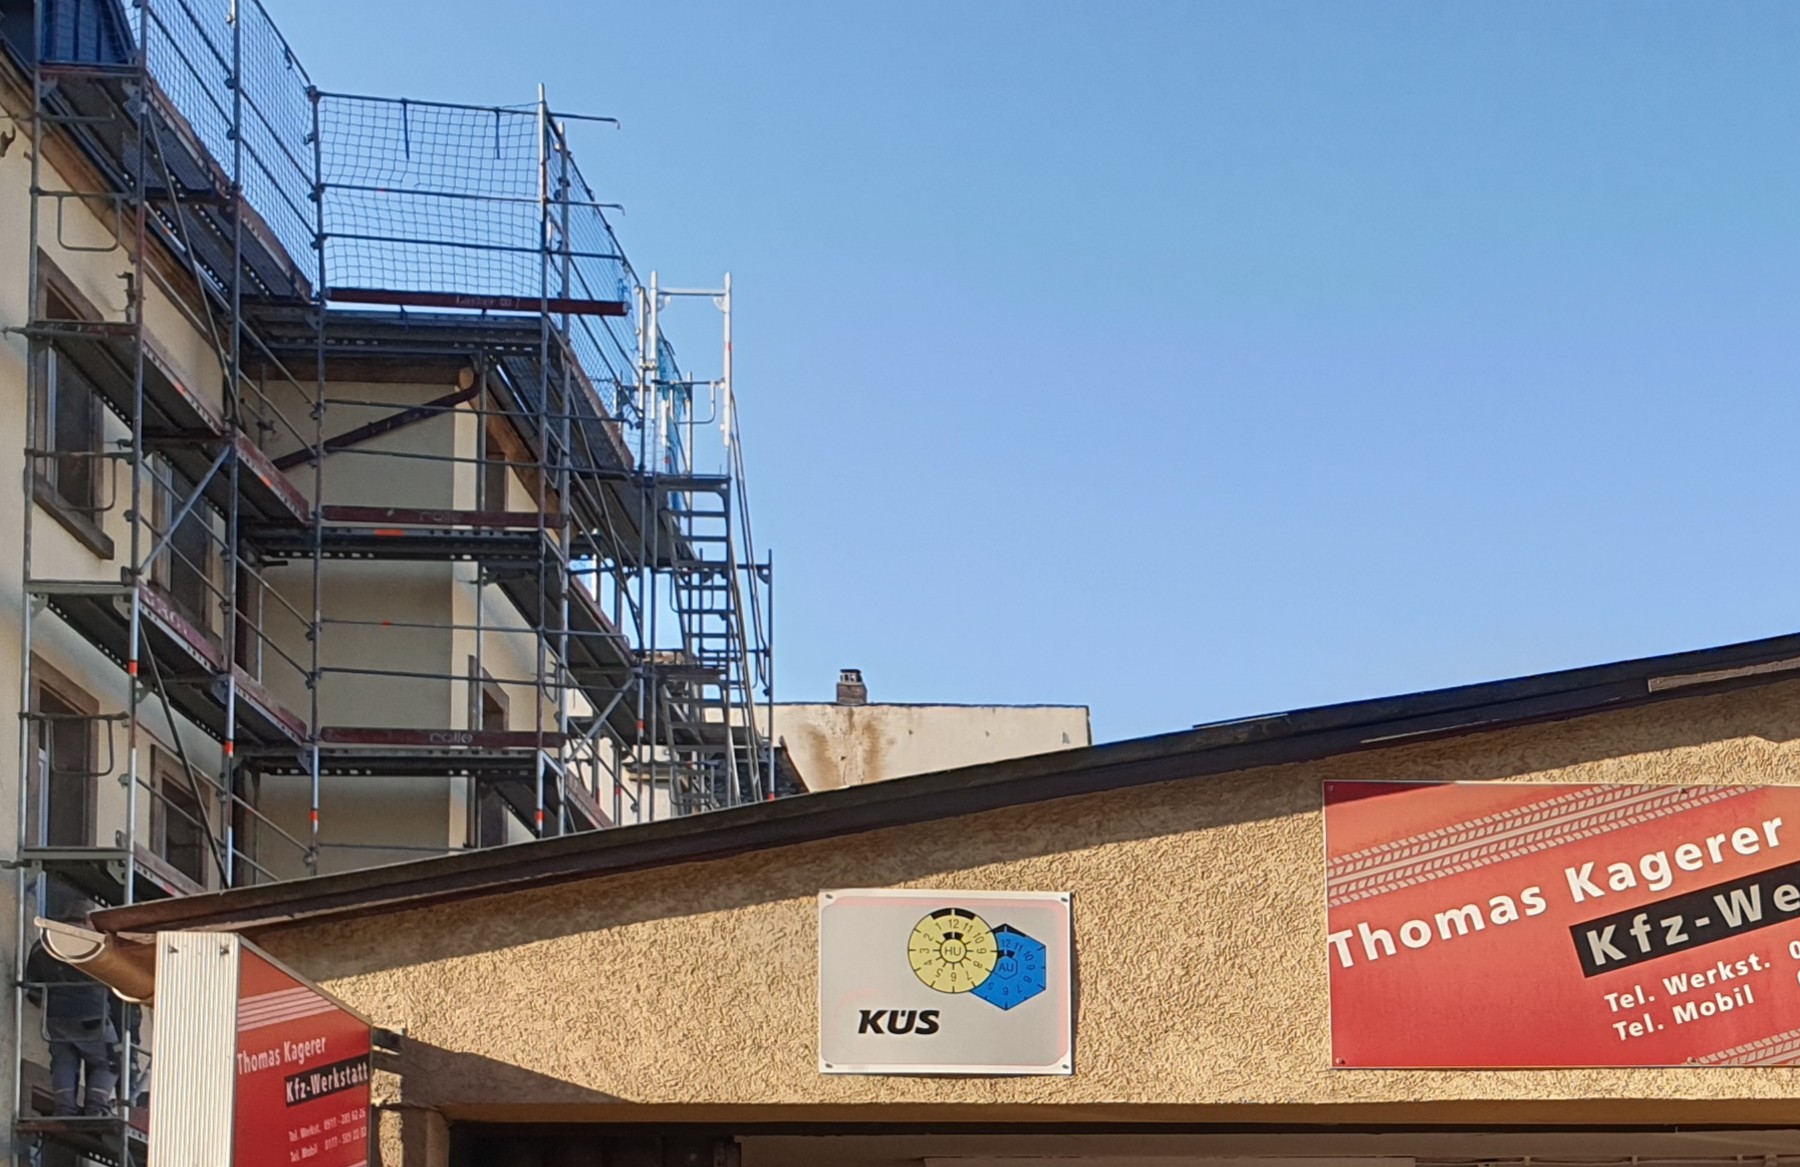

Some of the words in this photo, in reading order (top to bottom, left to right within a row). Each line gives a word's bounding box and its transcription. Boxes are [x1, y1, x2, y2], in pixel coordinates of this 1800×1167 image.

[1327, 886, 1547, 968] Thomas
[1564, 817, 1782, 903] Kagerer
[948, 919, 959, 929] 12
[963, 922, 974, 933] 11
[923, 932, 934, 942] 2
[973, 932, 985, 943] 10
[944, 946, 962, 956] HU
[998, 963, 1014, 972] AU
[1604, 985, 1655, 1013] Tel.
[1662, 952, 1771, 997] Werkst.
[1613, 1014, 1665, 1042] Tel.
[1672, 983, 1755, 1025] Mobil
[857, 1010, 940, 1035] KÜS
[237, 1048, 280, 1075] Thomas
[284, 1037, 326, 1065] Kagerer
[286, 1062, 368, 1103] Kfz-Werkstatt
